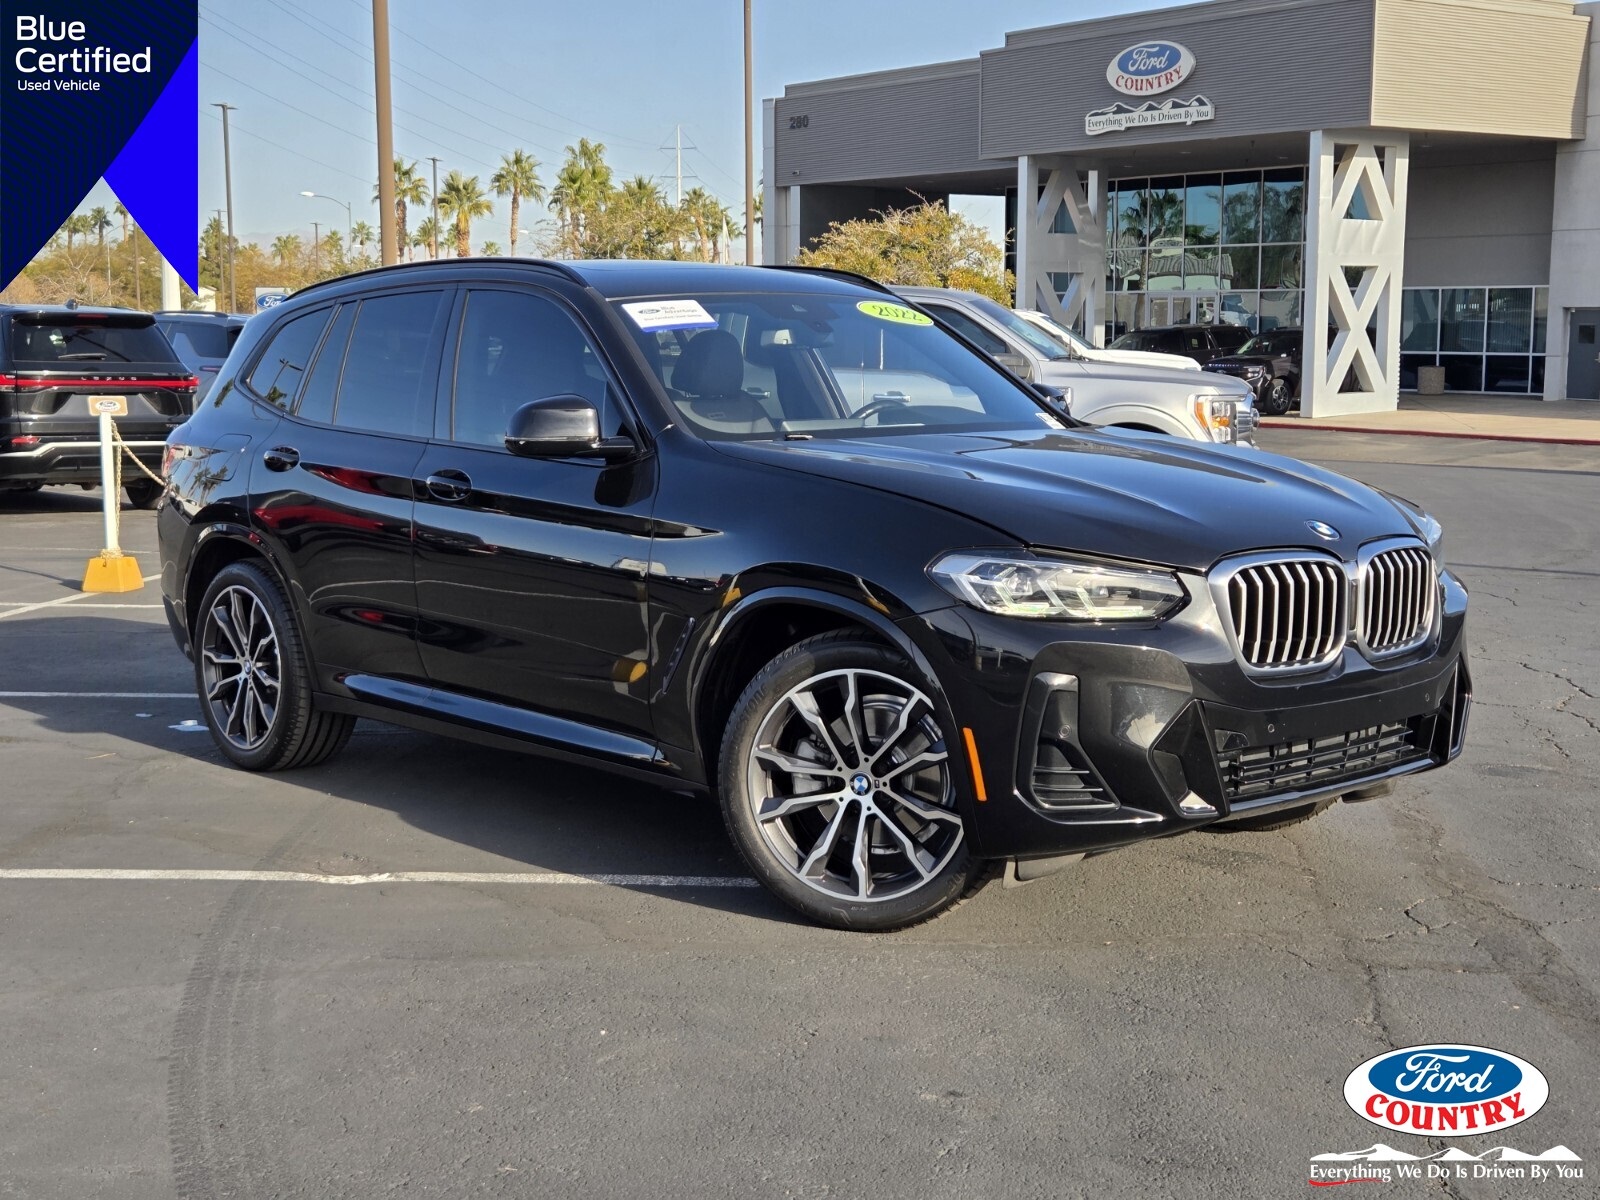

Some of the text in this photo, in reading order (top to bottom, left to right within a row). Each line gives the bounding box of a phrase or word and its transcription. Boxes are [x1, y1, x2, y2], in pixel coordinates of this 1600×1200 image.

[1128, 46, 1170, 72] Ford
[1115, 65, 1183, 91] COUNTRY
[1087, 109, 1209, 129] Everything We Do Is Driven By You
